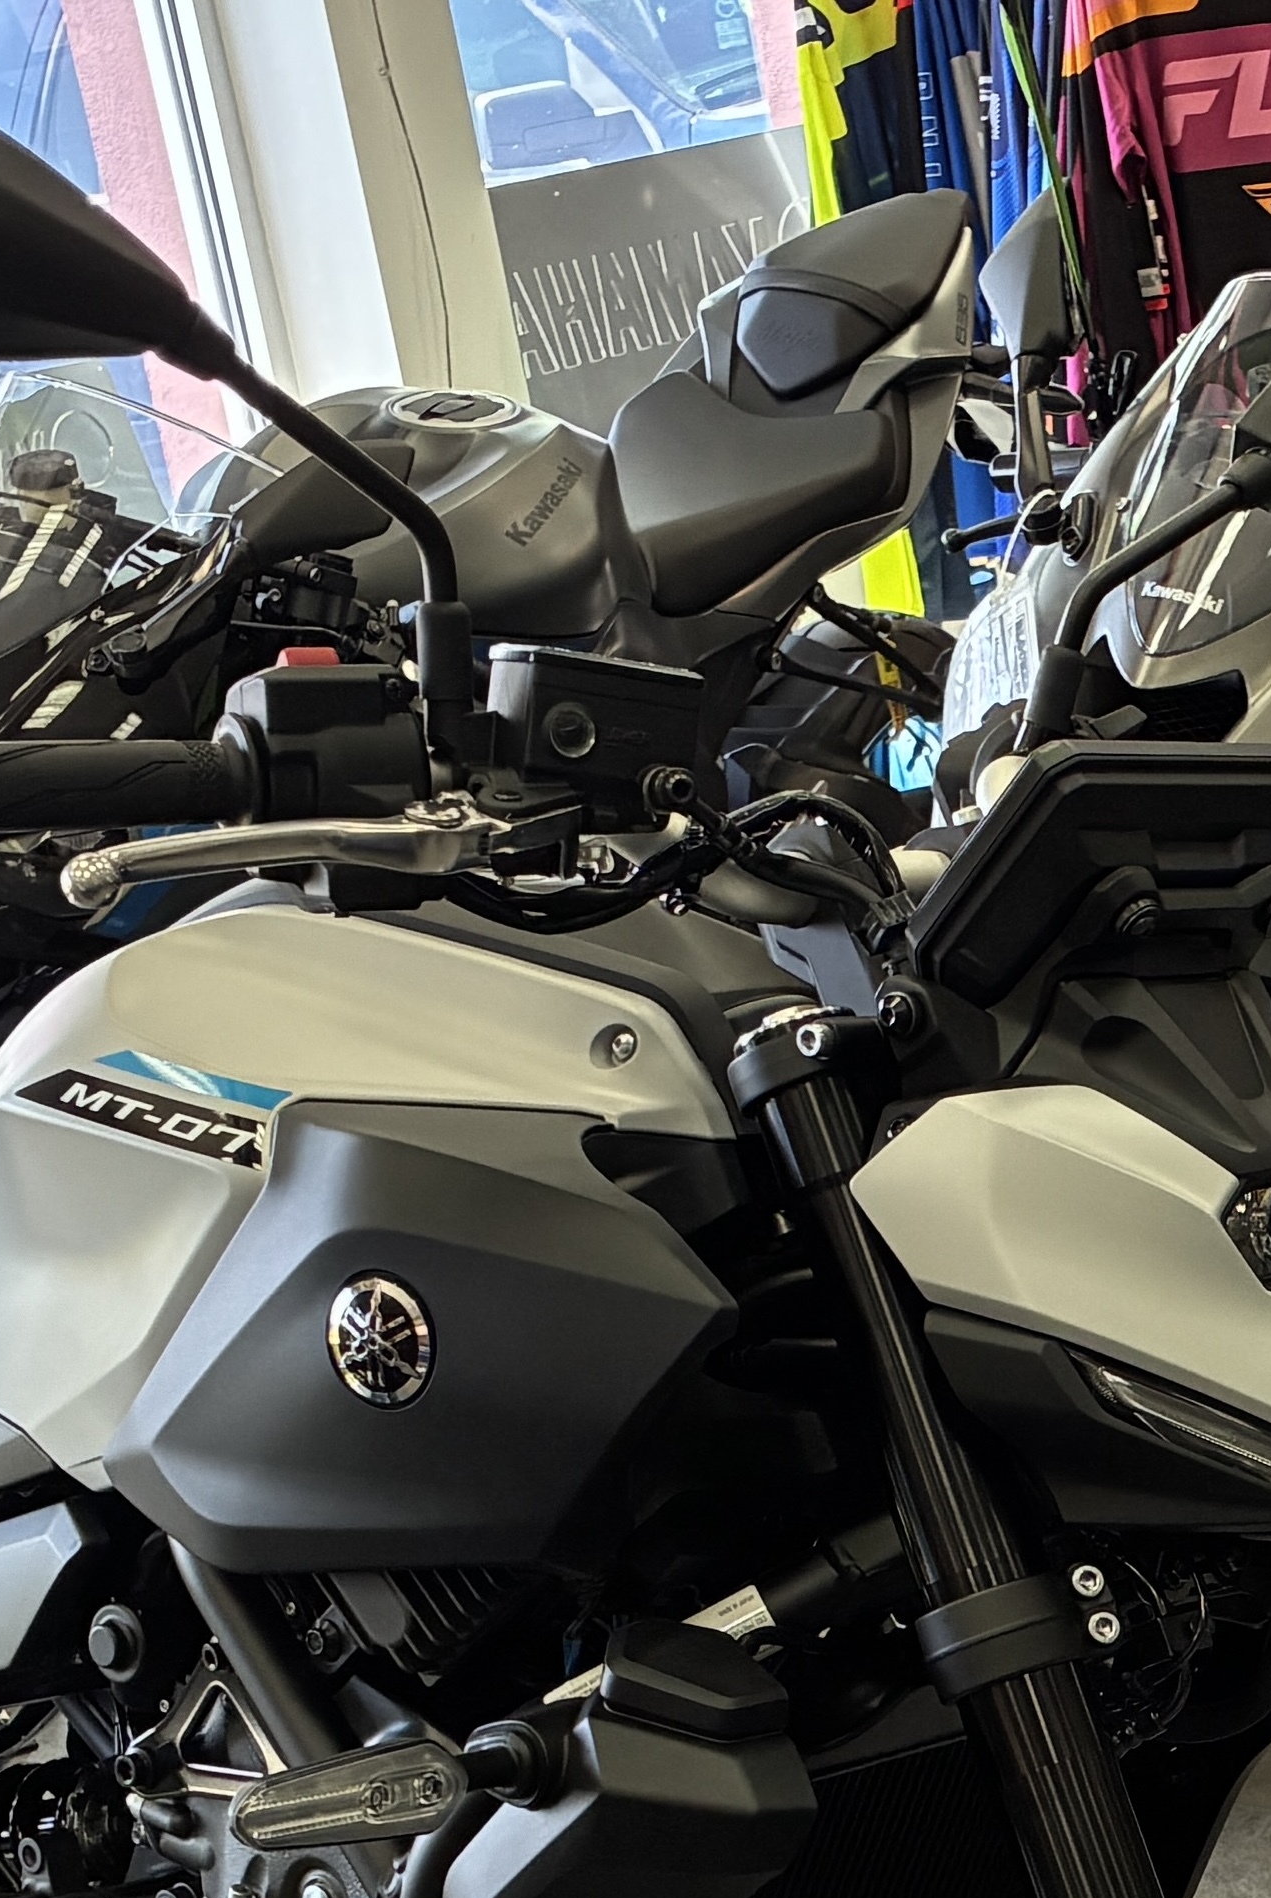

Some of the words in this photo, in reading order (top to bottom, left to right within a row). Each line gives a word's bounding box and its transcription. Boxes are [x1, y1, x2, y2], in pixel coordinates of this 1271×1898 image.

[505, 456, 583, 547] Kawasaki
[1140, 580, 1225, 615] Kawaski
[59, 1081, 256, 1154] MT-07
